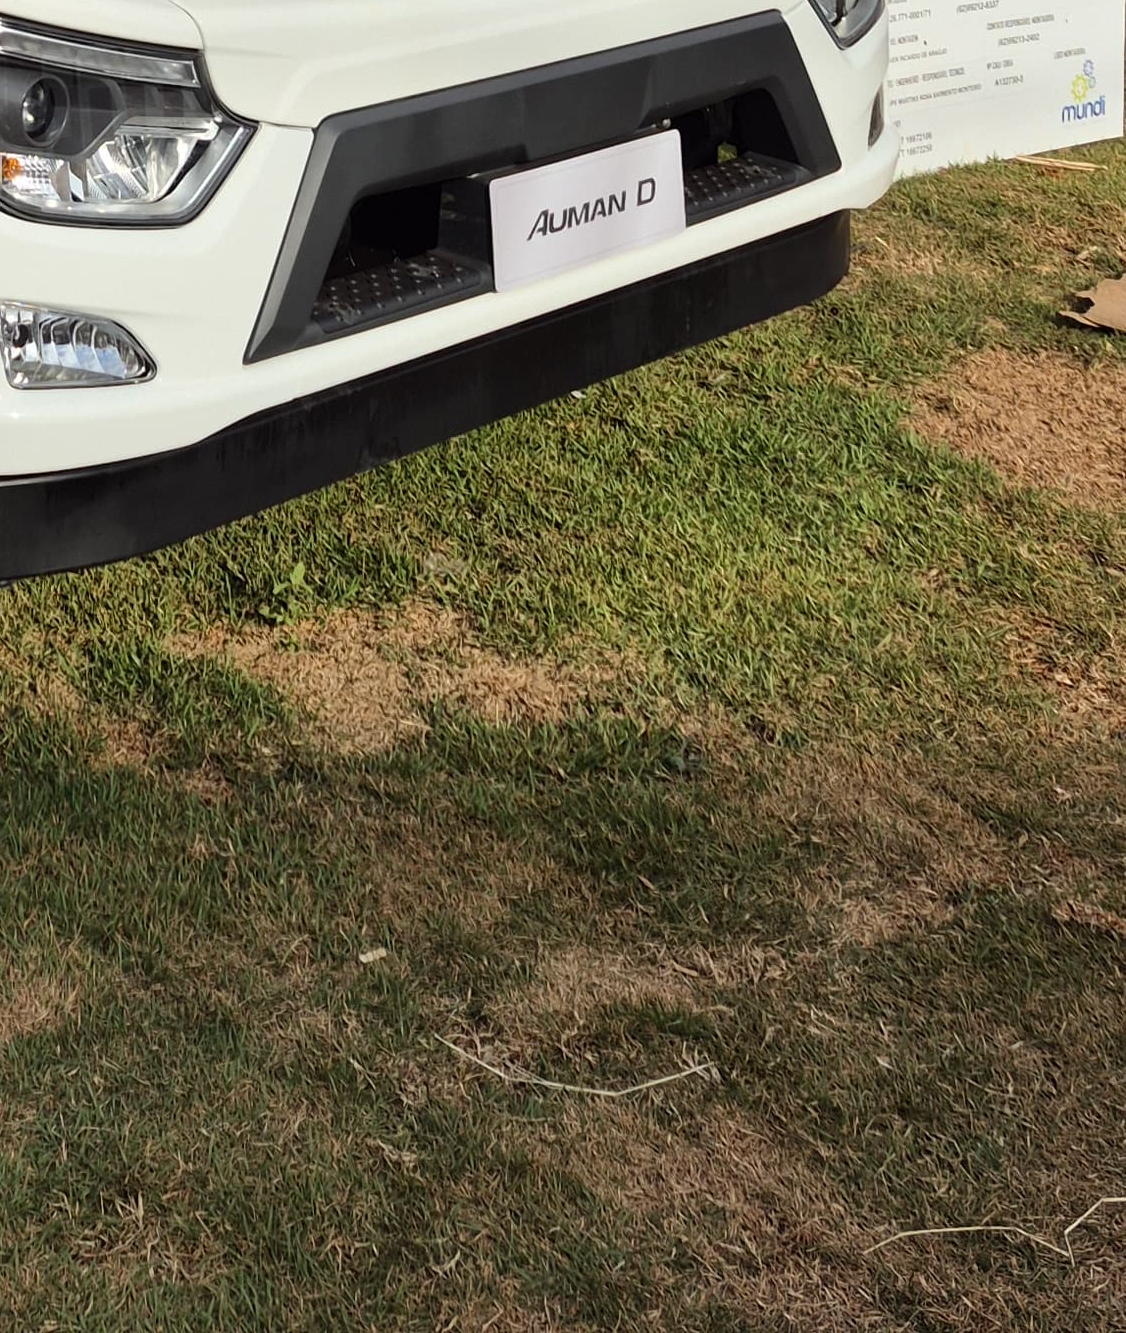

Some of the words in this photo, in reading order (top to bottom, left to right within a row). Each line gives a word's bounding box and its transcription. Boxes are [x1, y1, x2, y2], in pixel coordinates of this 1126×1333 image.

[1061, 94, 1106, 124] mundi
[526, 190, 627, 242] AUMAN
[636, 177, 656, 207] D
